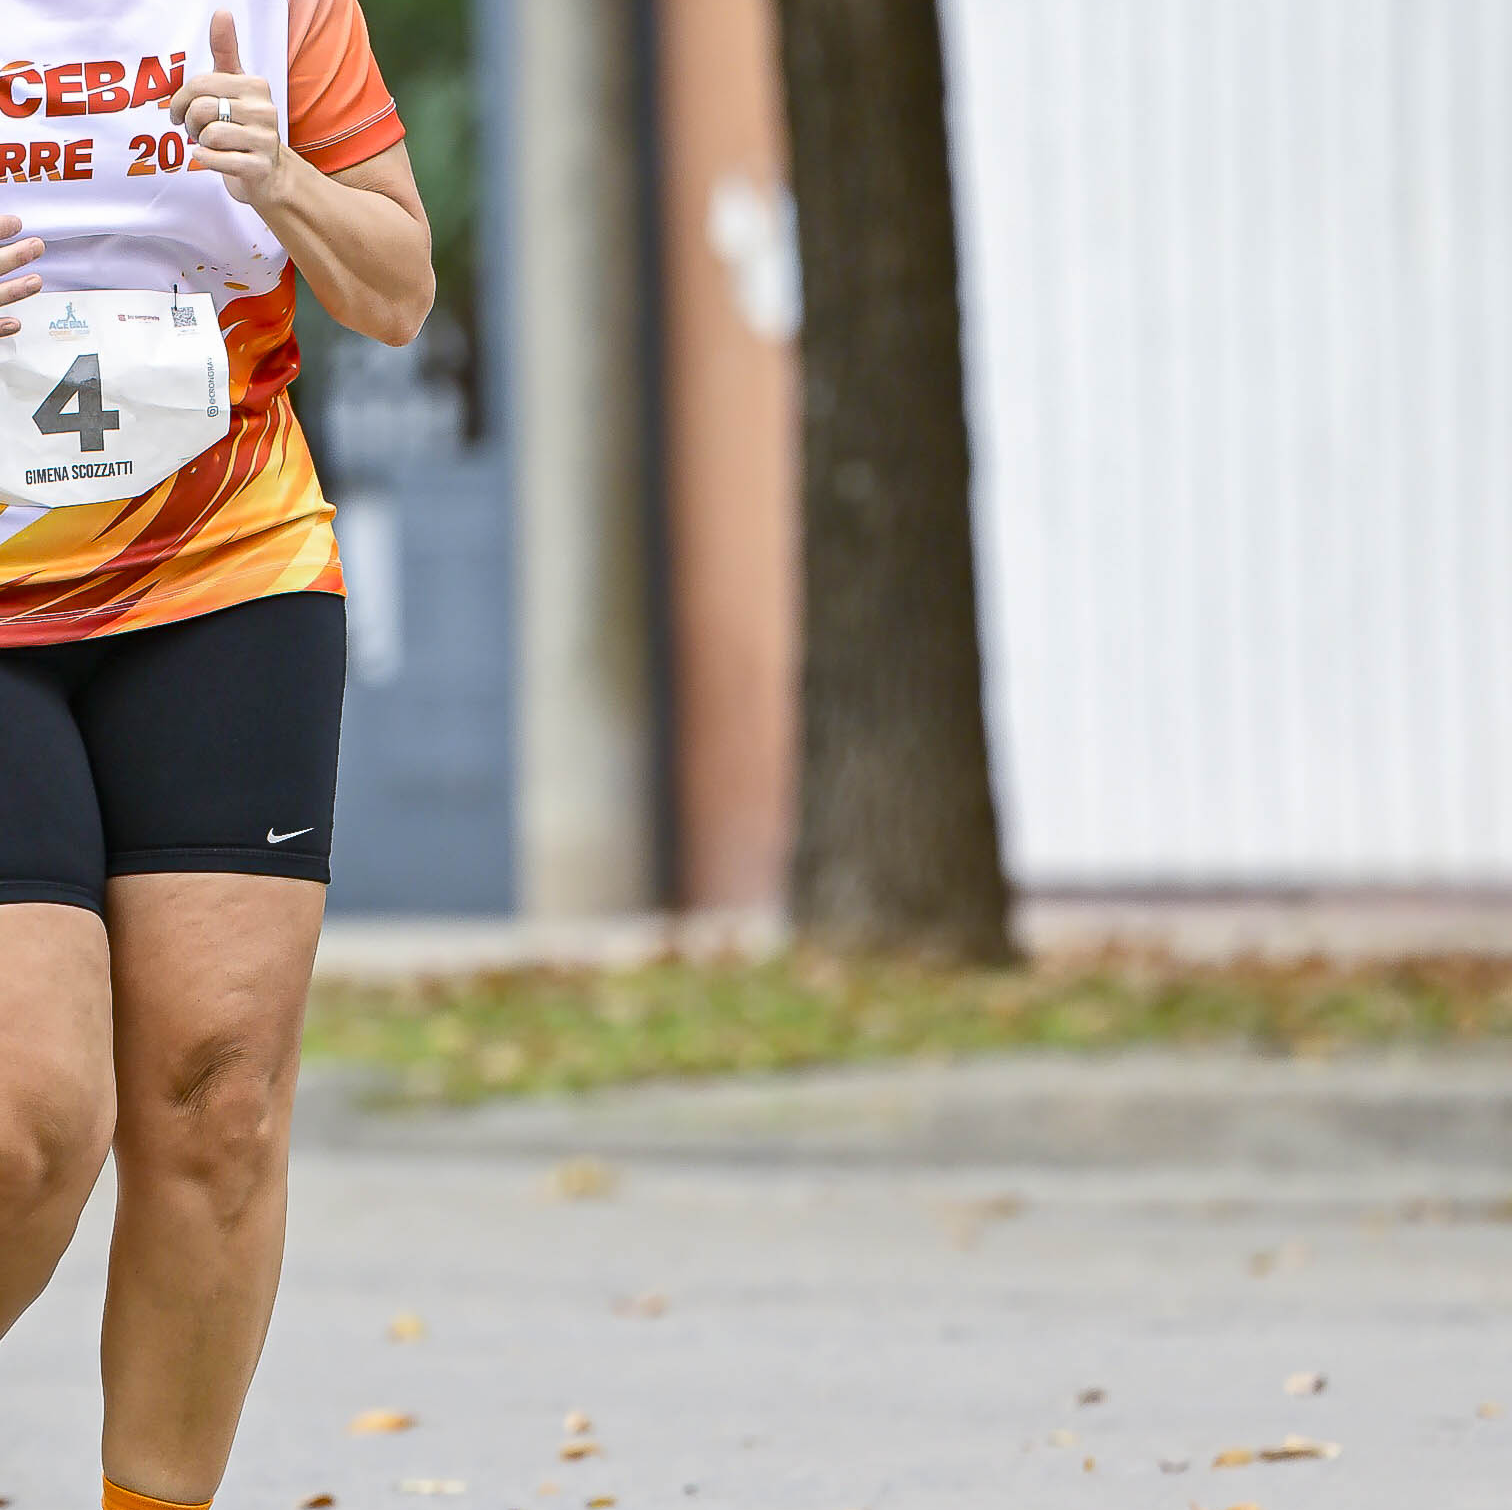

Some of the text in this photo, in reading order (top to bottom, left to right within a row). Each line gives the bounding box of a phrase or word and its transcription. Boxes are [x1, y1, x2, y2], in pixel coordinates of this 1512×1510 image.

[127, 132, 209, 177] 20
[32, 353, 120, 452] 4
[25, 461, 133, 485] GIMENA SCOZZATTI
